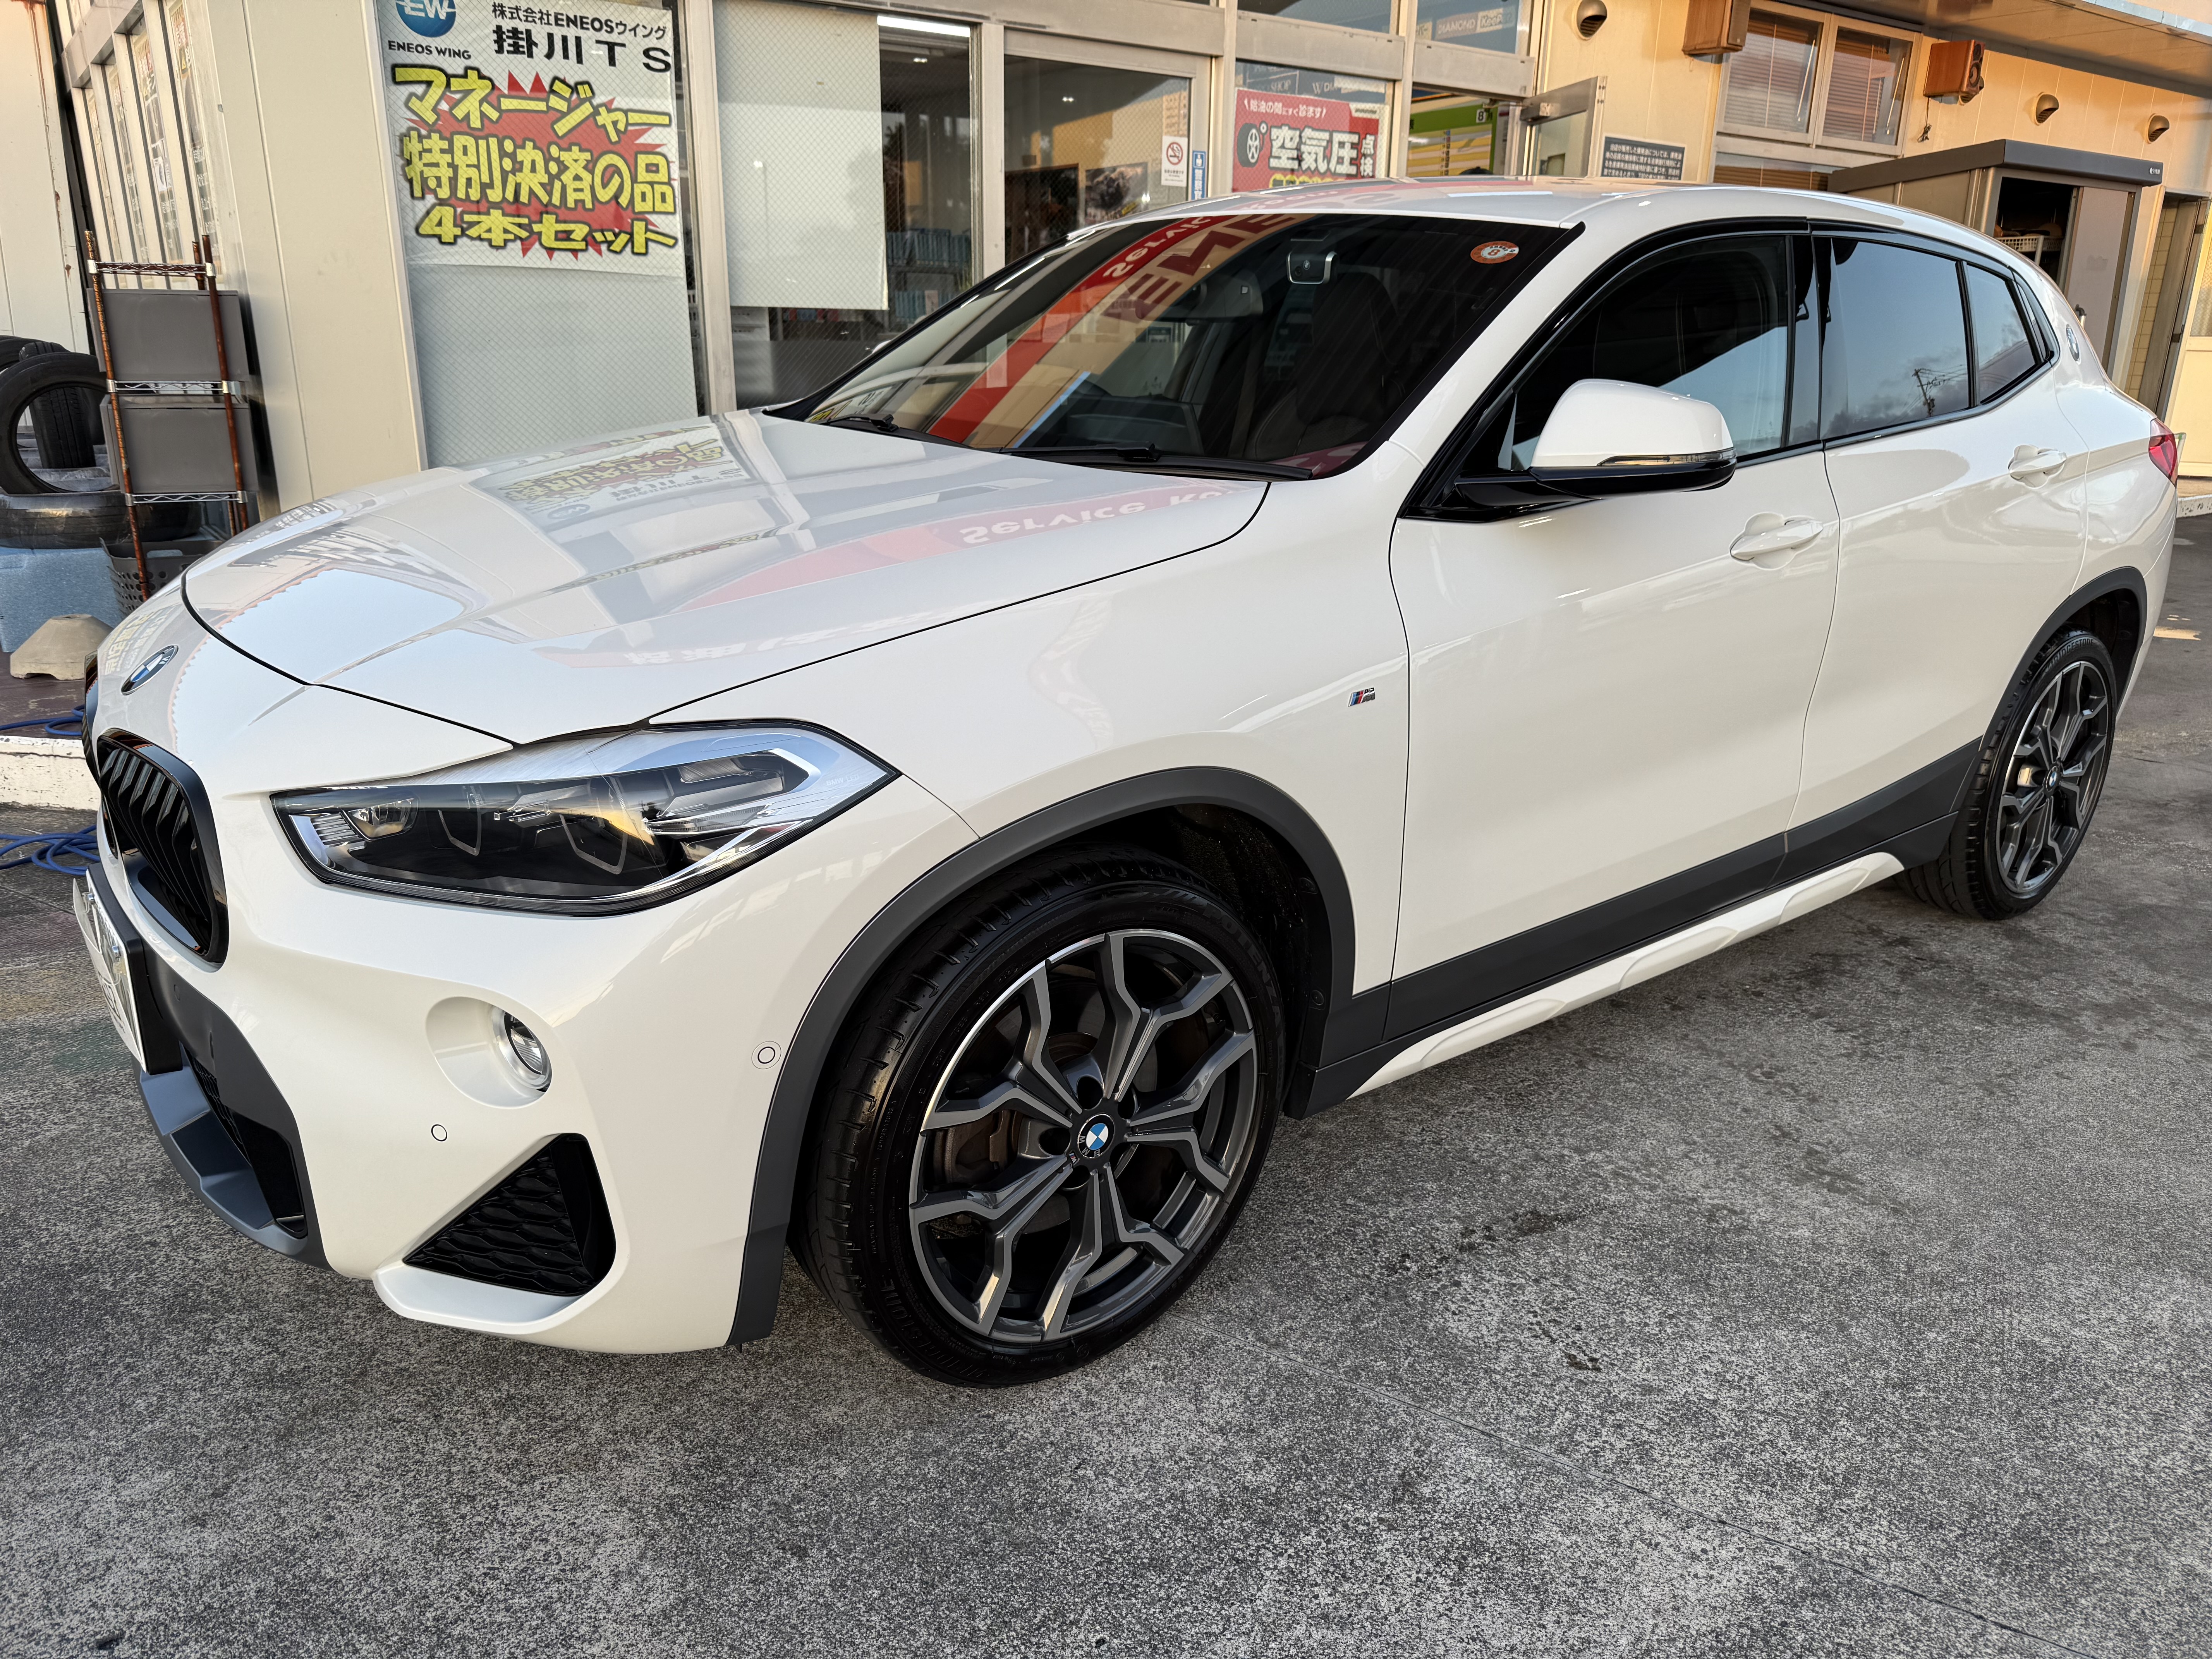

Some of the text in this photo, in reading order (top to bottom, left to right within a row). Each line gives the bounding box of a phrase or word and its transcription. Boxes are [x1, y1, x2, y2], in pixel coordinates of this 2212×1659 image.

[492, 2, 667, 40] 株式会社ENEOSウイング
[388, 40, 472, 60] ENEOS WING
[392, 64, 671, 143] マネージャー
[401, 129, 677, 214] 特別決済の品
[1269, 125, 1360, 177] 空気圧
[1360, 134, 1376, 177] 点検
[416, 204, 678, 255] 4本セット
